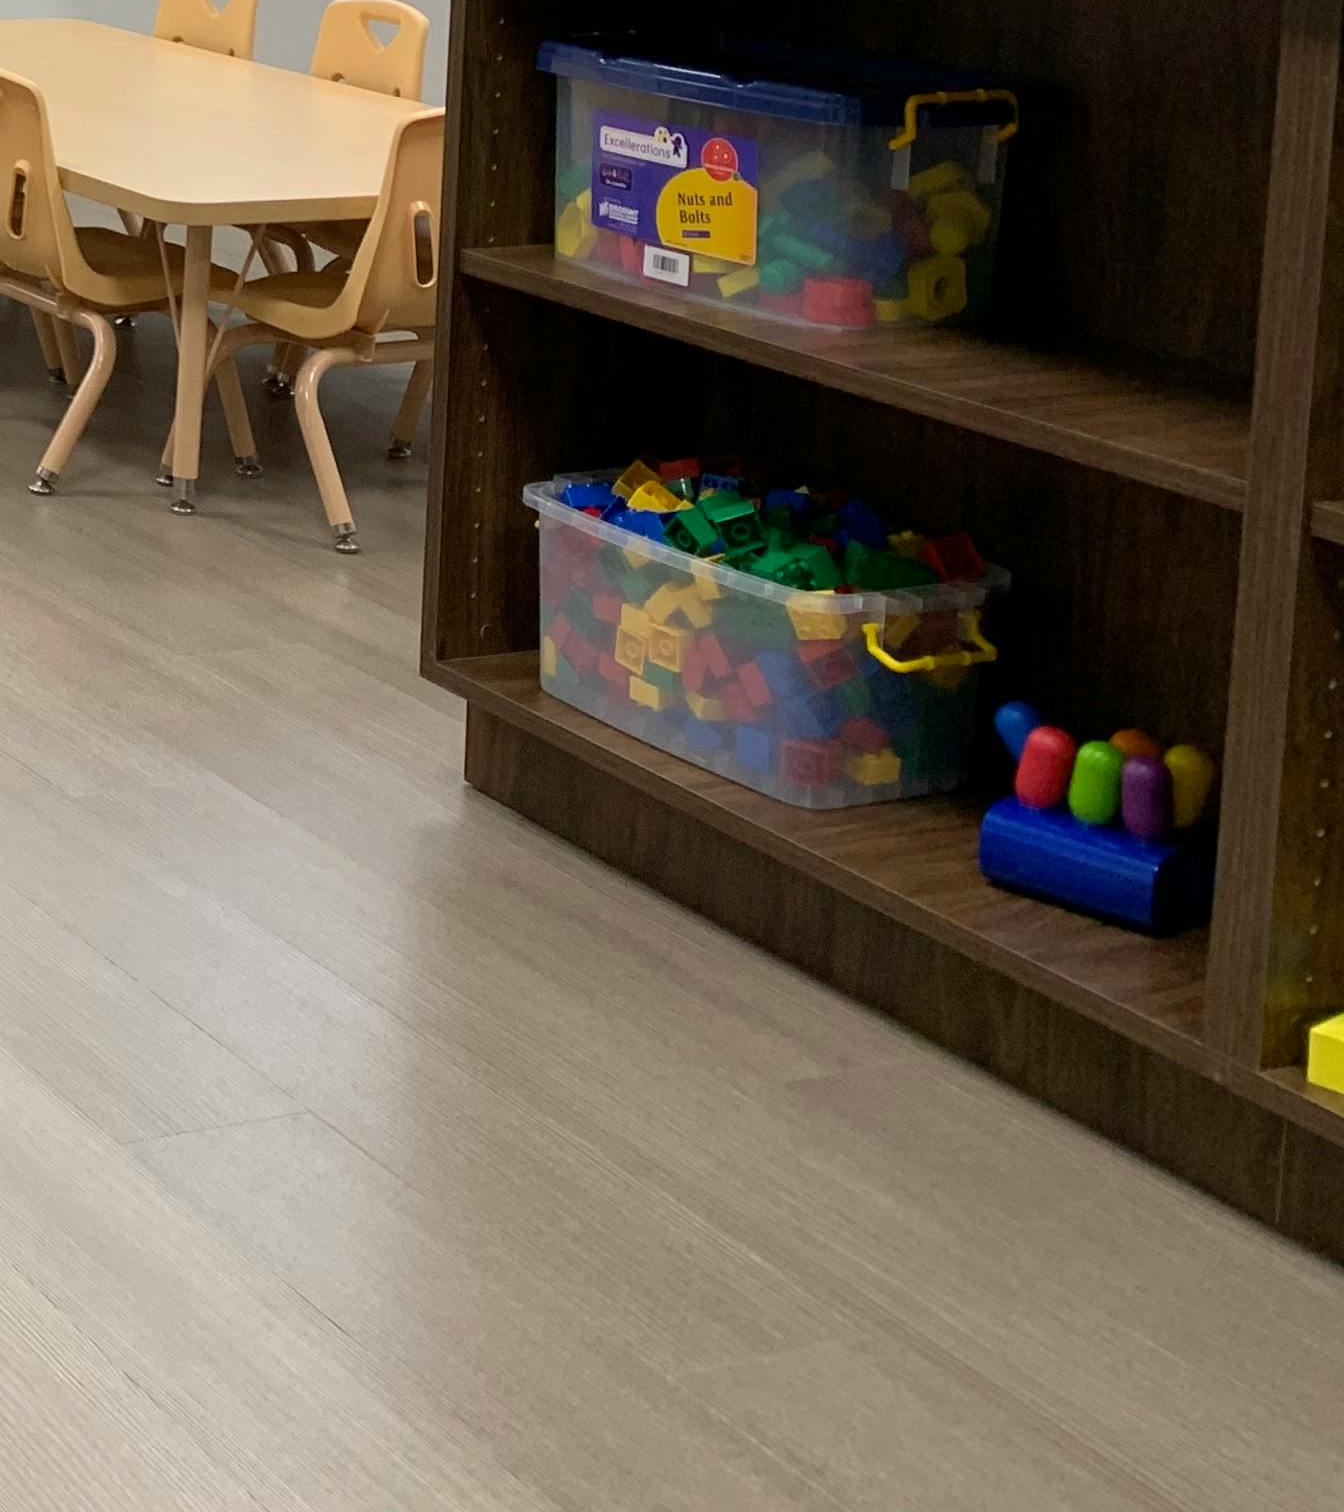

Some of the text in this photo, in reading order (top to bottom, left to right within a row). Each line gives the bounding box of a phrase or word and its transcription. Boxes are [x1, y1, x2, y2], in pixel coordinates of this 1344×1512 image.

[604, 133, 671, 159] Excellerations
[677, 191, 733, 206] Nuts and
[679, 209, 712, 224] Bolts
